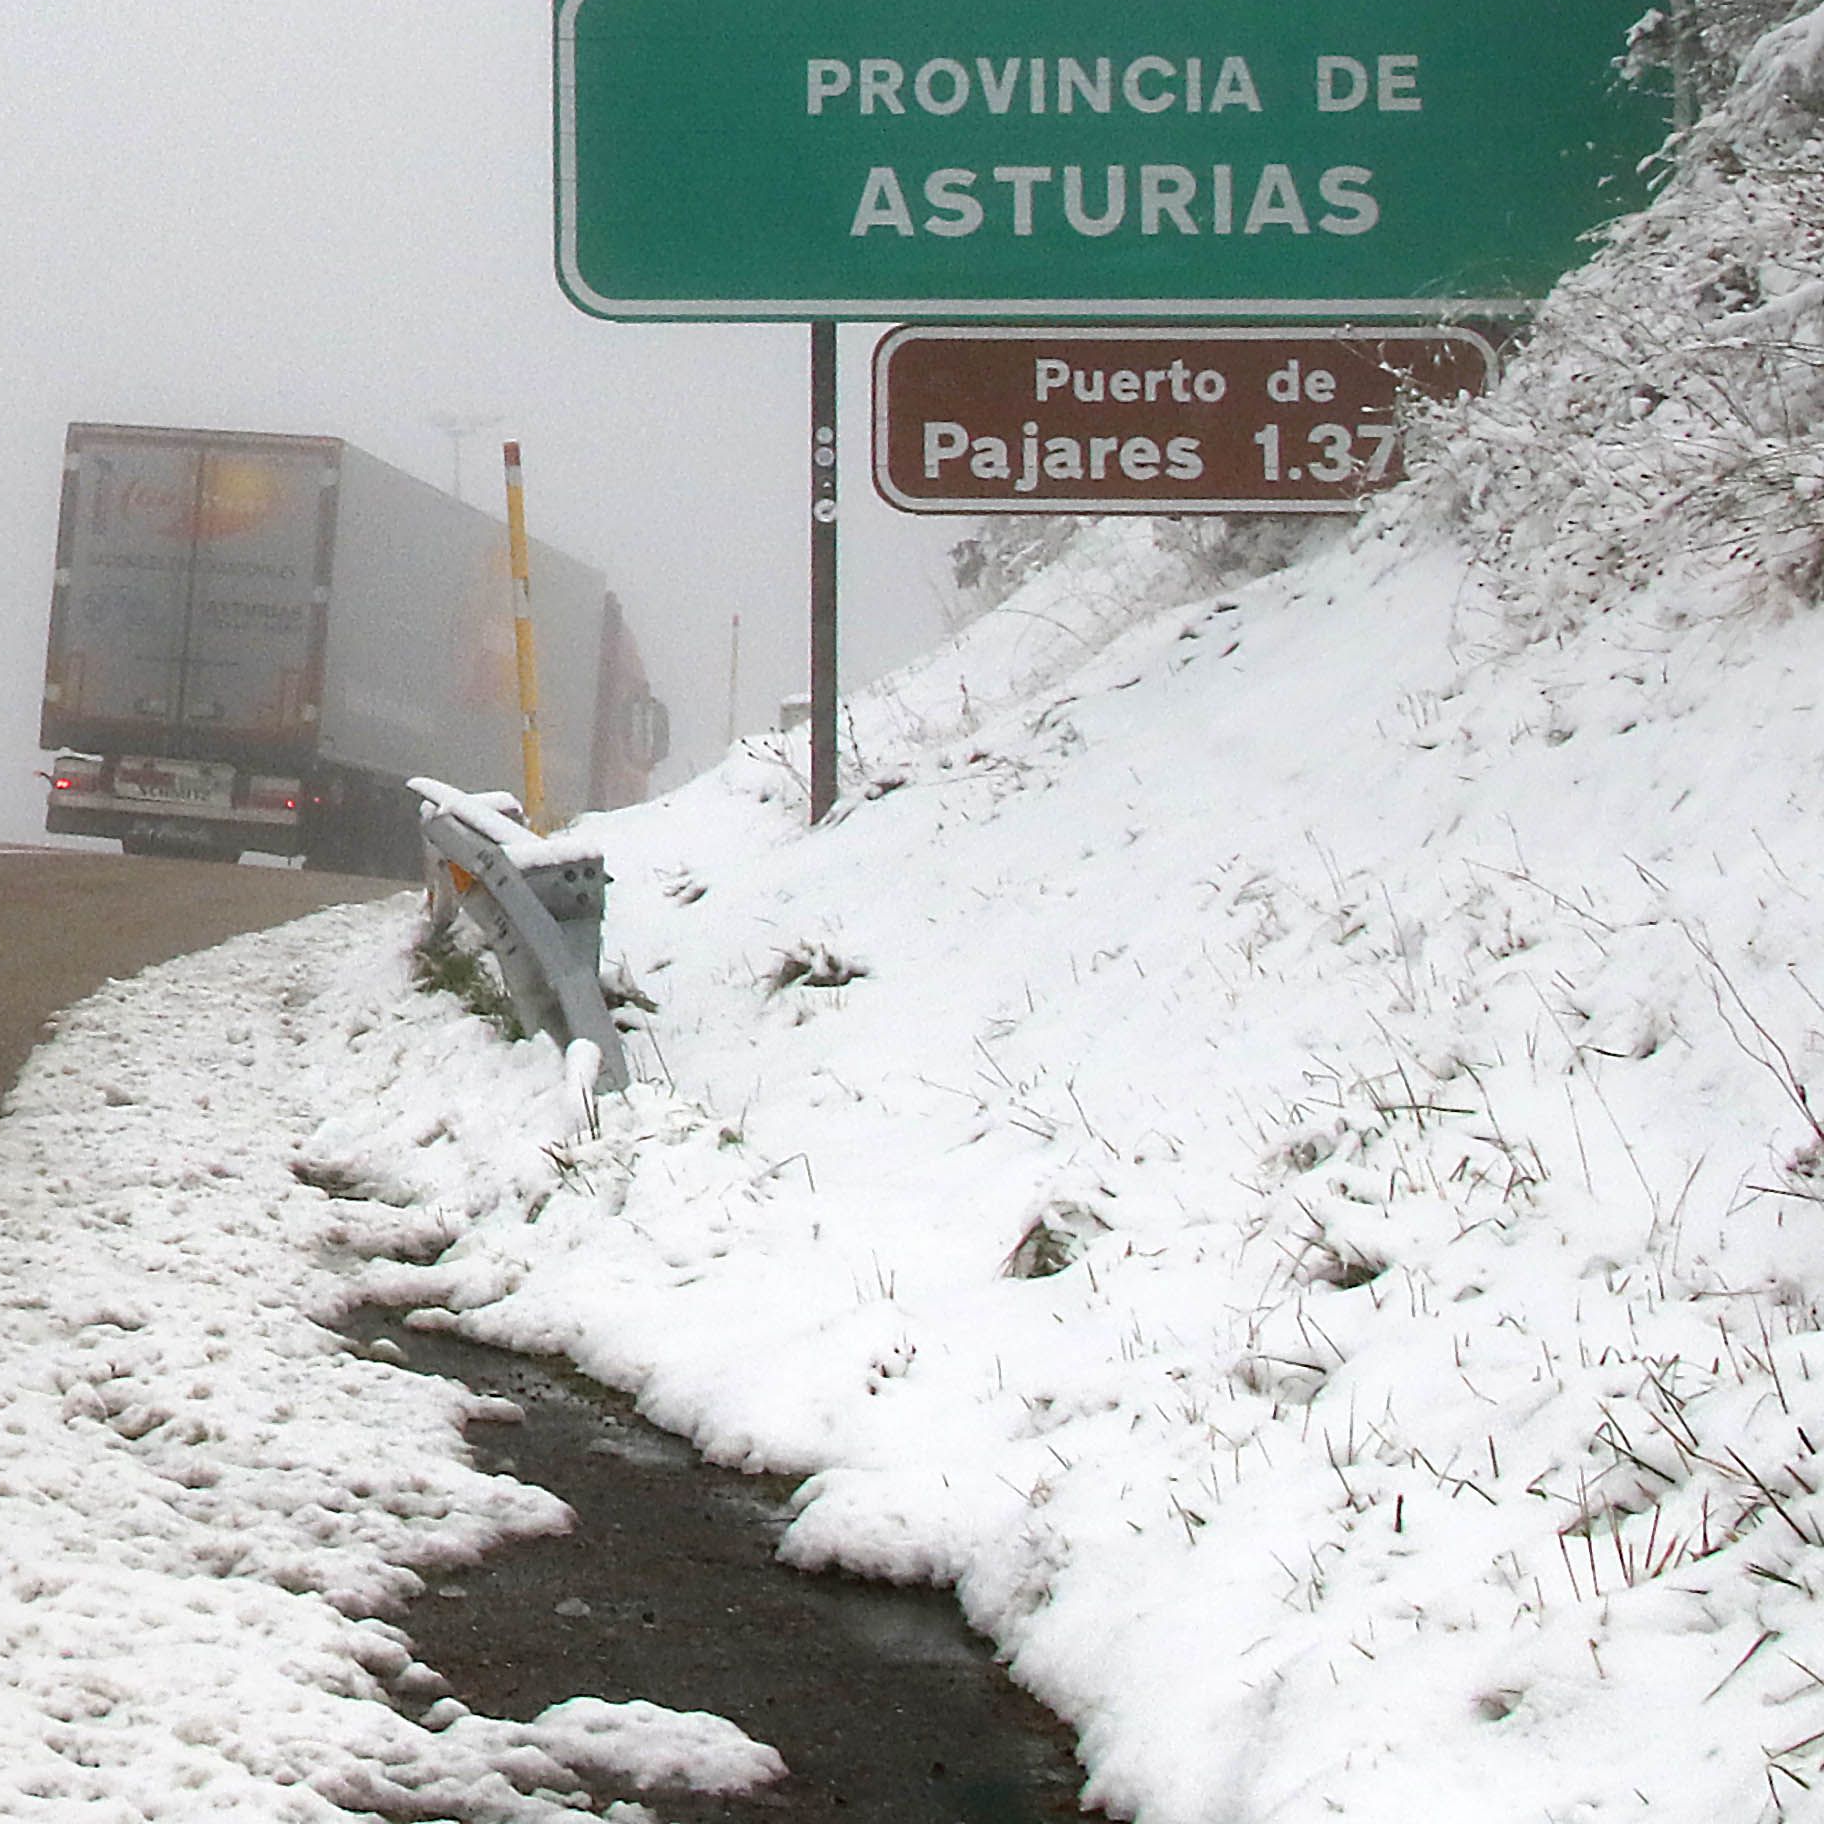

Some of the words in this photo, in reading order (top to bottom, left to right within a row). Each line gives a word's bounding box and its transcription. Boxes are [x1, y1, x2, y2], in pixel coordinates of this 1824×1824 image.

[806, 54, 1263, 116] PROVINCIA
[1316, 54, 1423, 113] DE
[851, 164, 1381, 239] ASTURIAS
[1034, 358, 1228, 405] Puerto
[1266, 359, 1336, 403] de
[922, 422, 1204, 493] Pajares
[1254, 423, 1398, 482] 1.37
